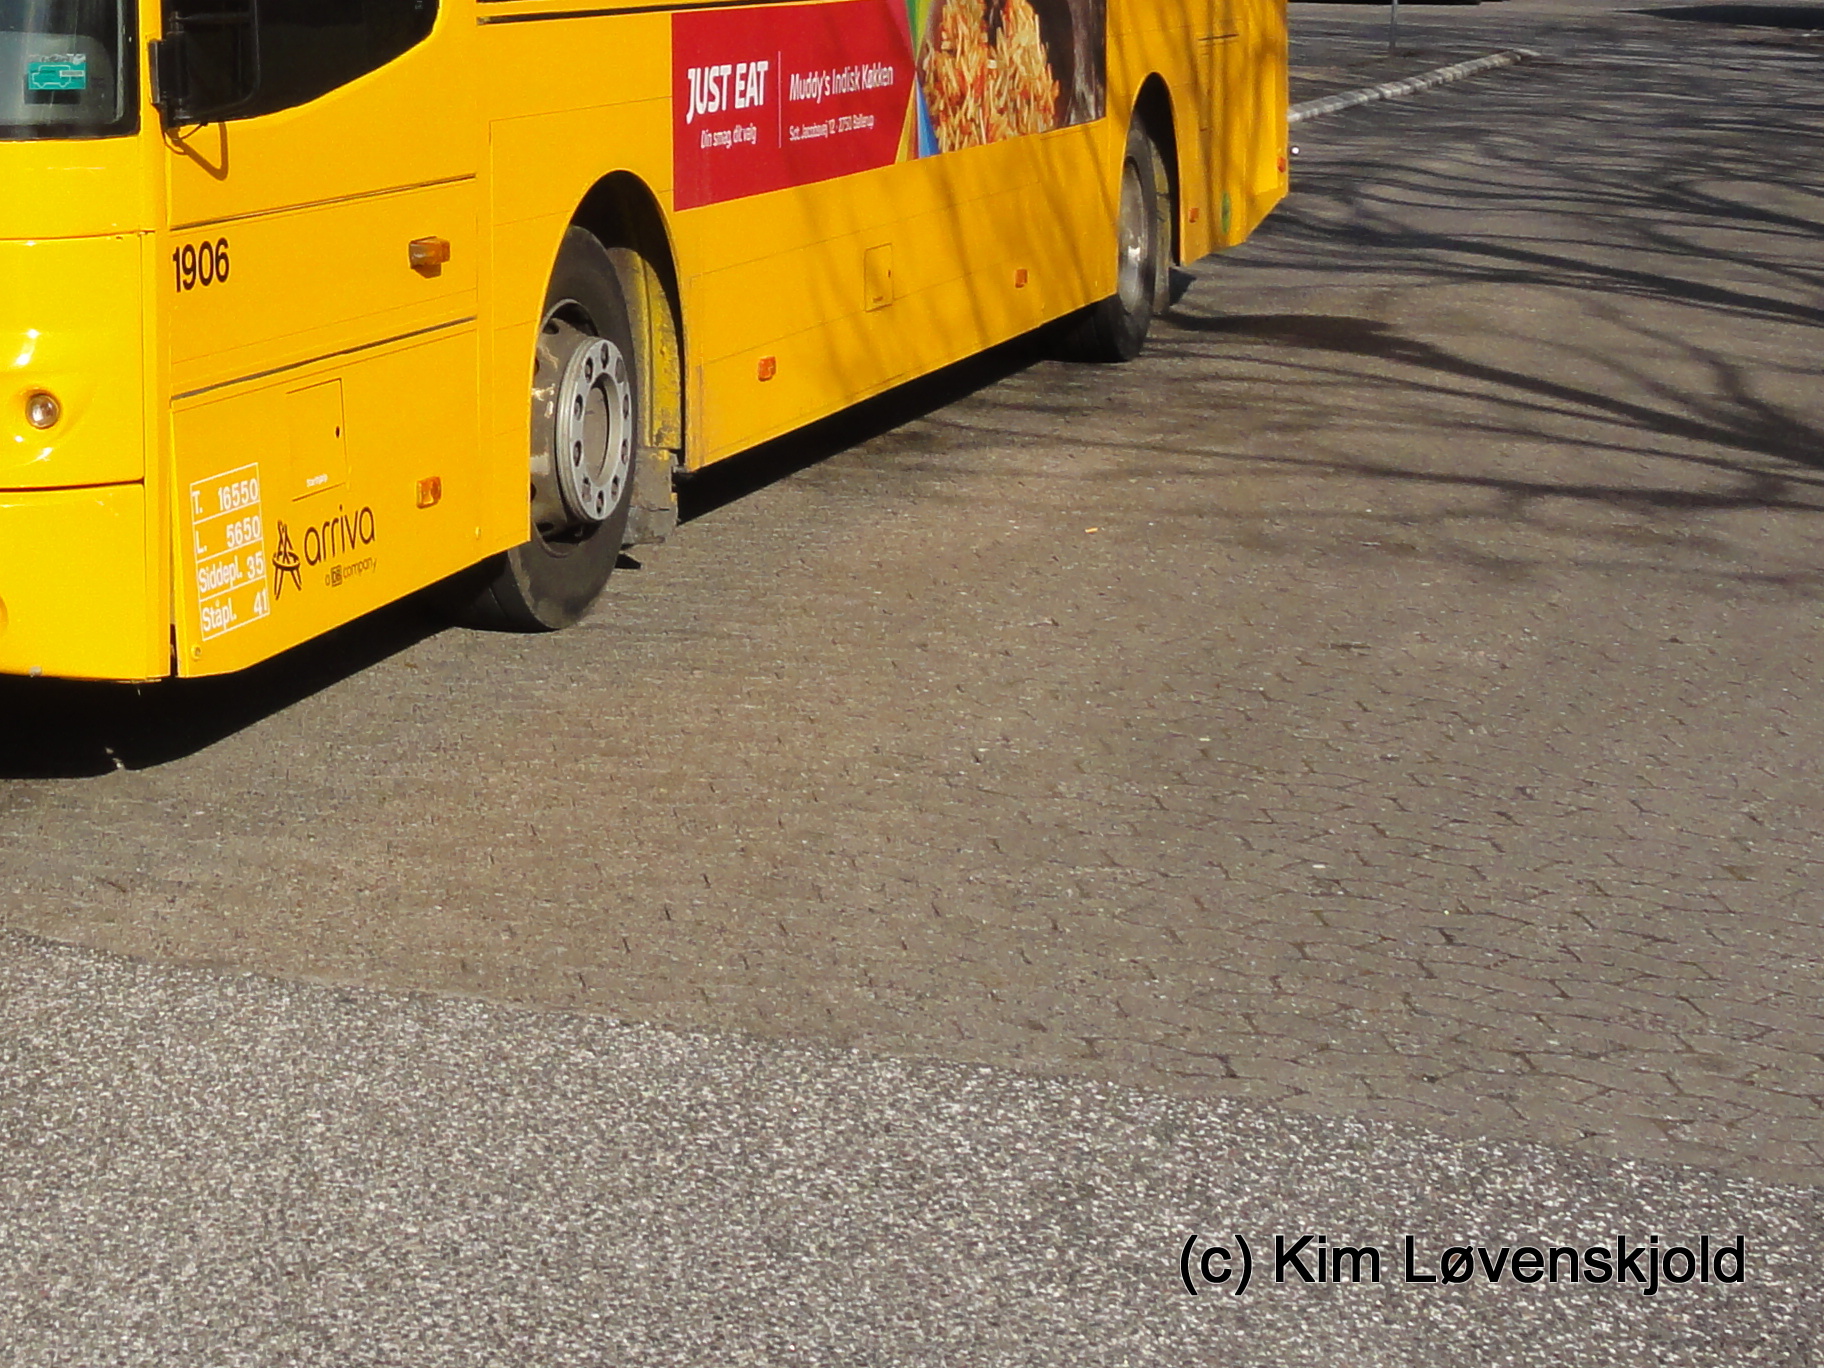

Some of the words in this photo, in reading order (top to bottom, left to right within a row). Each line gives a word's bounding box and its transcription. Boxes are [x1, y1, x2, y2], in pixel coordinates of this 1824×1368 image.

[686, 64, 732, 125] JUST
[735, 60, 769, 109] EAT
[789, 70, 831, 104] Muddy's
[832, 65, 861, 95] Indisk
[172, 237, 230, 293] 1906
[218, 478, 259, 512] 16550
[195, 529, 208, 555] L.
[226, 515, 262, 549] 5650
[304, 504, 376, 567] arriva
[198, 554, 243, 594] Siddepl.
[246, 551, 264, 580] 35
[324, 573, 331, 587] a
[342, 556, 377, 580] company
[202, 596, 238, 633] Ståpl.
[253, 587, 269, 615] 41
